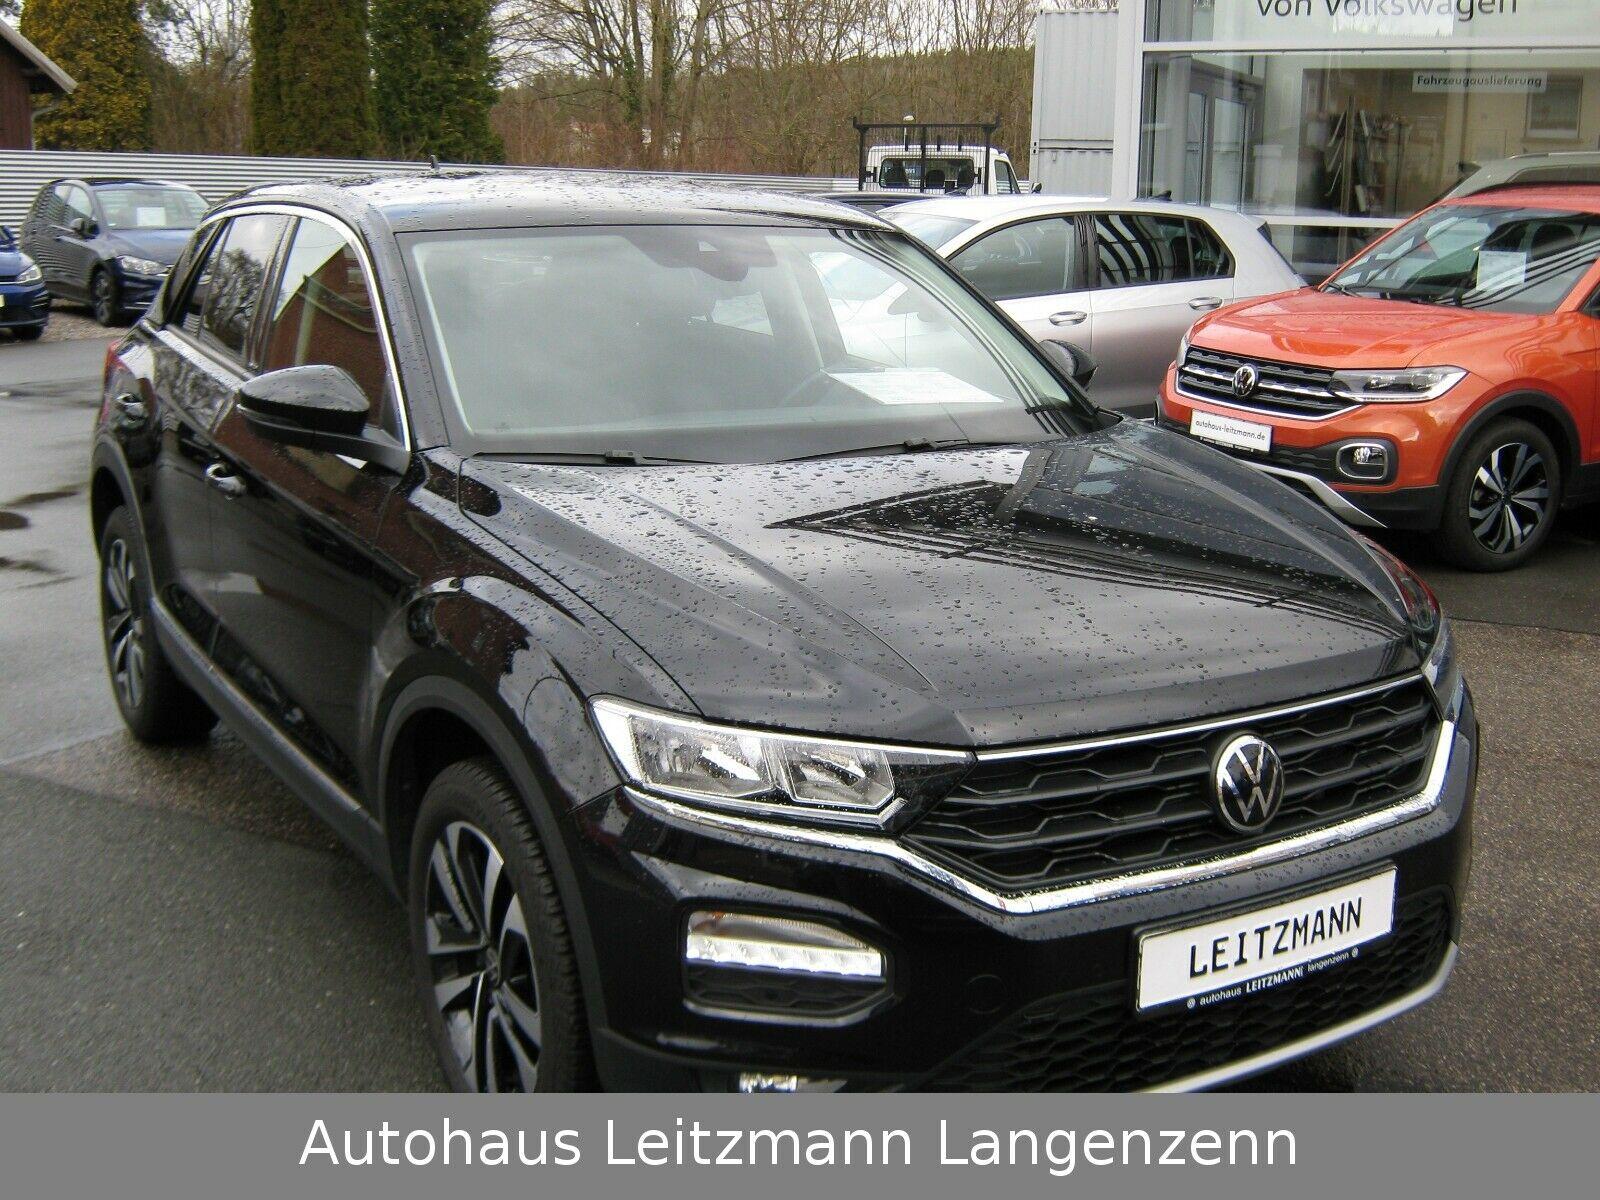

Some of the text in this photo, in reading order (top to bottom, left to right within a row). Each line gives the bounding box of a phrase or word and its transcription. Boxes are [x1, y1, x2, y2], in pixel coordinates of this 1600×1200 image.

[1416, 75, 1542, 87] Fahrzeugauslieferung
[1195, 420, 1266, 441] autohaus-leitzmann.de
[1215, 733, 1284, 832] VW
[1189, 897, 1363, 978] LEITZMANN
[1199, 952, 1350, 1006] autohaus LEITZMANN langenzenn
